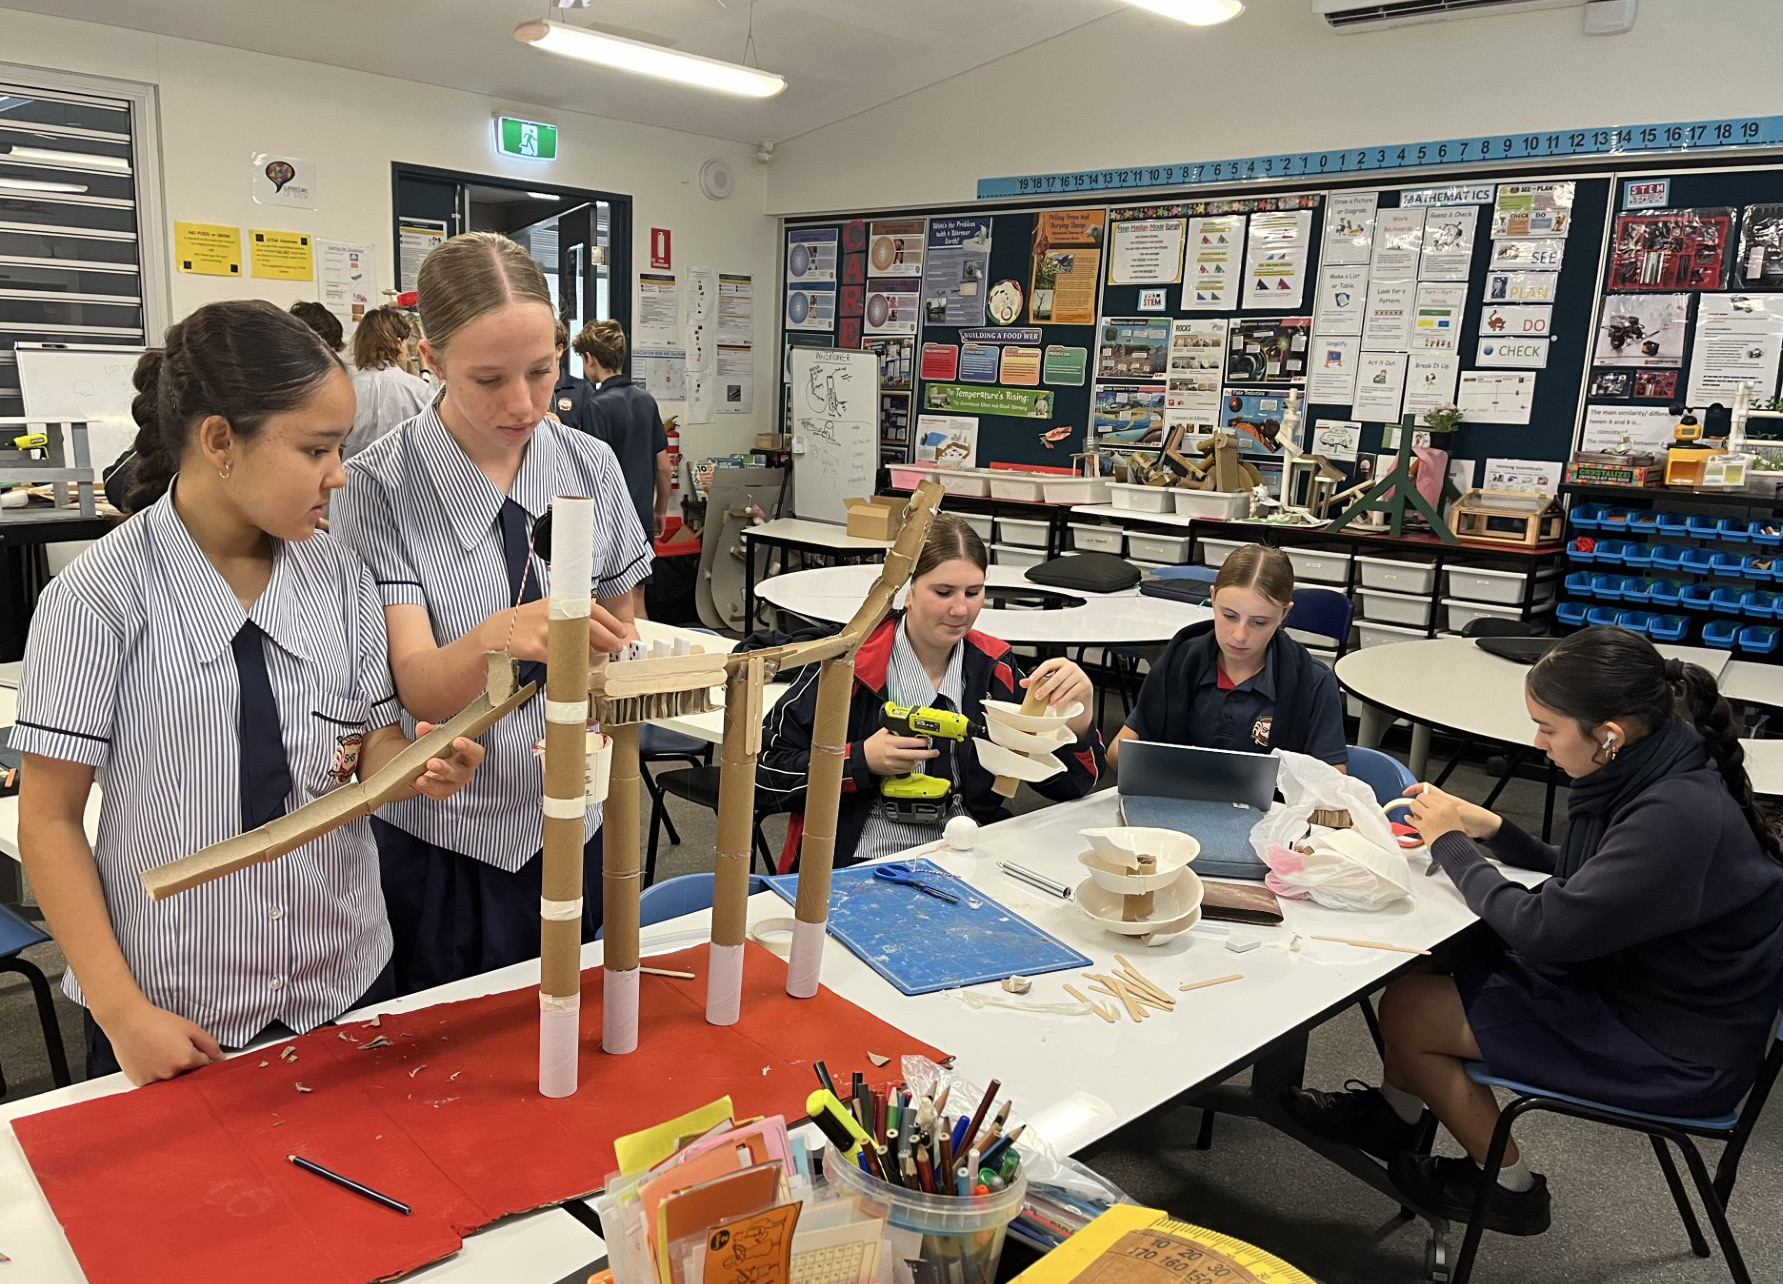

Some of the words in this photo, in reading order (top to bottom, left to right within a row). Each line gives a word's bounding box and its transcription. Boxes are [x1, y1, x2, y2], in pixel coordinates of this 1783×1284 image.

[1319, 155, 1327, 167] 0
[1340, 153, 1346, 166] 1
[1357, 152, 1366, 164] 2
[1377, 150, 1386, 162] 3
[1397, 148, 1406, 161] 4
[1417, 146, 1426, 159] 5
[1438, 144, 1447, 158] 6
[1460, 142, 1469, 156] 7
[1481, 141, 1490, 154] 8
[1503, 139, 1512, 152] 9
[1522, 136, 1539, 150] 10
[1546, 135, 1560, 149] 11
[1569, 133, 1585, 147] 12
[1592, 132, 1608, 145] 13
[1616, 130, 1632, 144] 14
[1640, 128, 1657, 143] 15
[1664, 127, 1682, 141] 16
[1689, 125, 1707, 140] 17
[1714, 124, 1732, 139] 18
[1741, 122, 1759, 137] 19
[1631, 183, 1664, 195] STEM
[1403, 189, 1490, 205] MATHEMATICS
[1130, 224, 1149, 232] Median
[1149, 223, 1165, 231] Mode
[1531, 251, 1557, 264] SEE
[1509, 286, 1548, 299] PLAN
[1143, 297, 1161, 307] STEM
[1175, 324, 1191, 332] ROCKS
[1523, 319, 1546, 332] DO
[964, 330, 996, 340] BUILDING
[1003, 332, 1022, 340] FOOD
[1023, 332, 1039, 340] WEB
[1325, 340, 1347, 349] Simplify
[1498, 345, 1541, 357] CHECK
[1415, 362, 1432, 370] Break
[955, 387, 1004, 400] Temperature's
[1150, 1237, 1170, 1250] 10
[1178, 1248, 1203, 1262] 20
[1208, 1262, 1232, 1278] 30
[1128, 1247, 1158, 1260] 170
[1160, 1255, 1189, 1272] 160
[1187, 1267, 1213, 1284] 150
